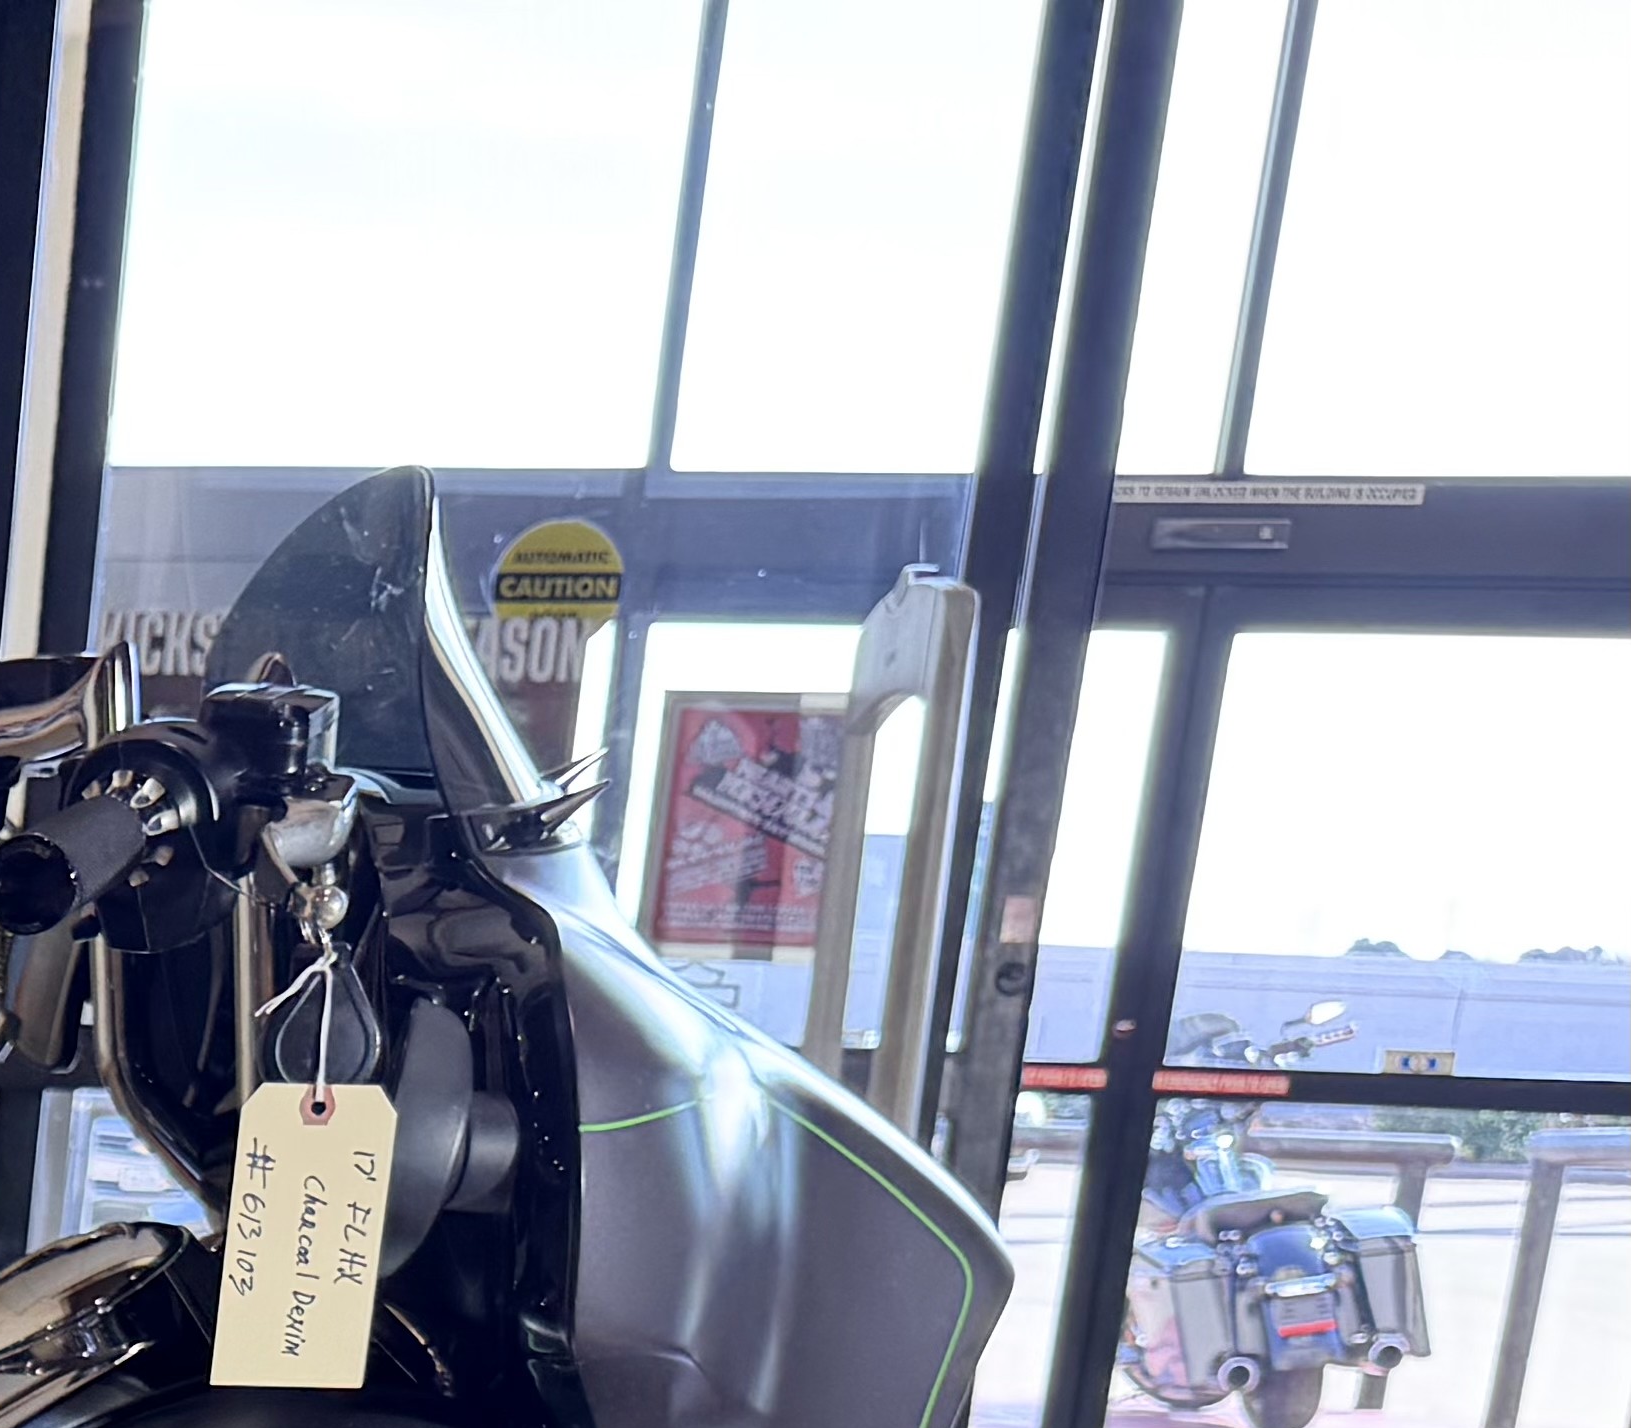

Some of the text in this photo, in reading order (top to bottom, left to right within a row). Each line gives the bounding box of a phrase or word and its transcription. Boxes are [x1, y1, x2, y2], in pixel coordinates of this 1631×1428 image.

[498, 575, 619, 599] CAUTION
[97, 611, 591, 683] KICKS ASON
